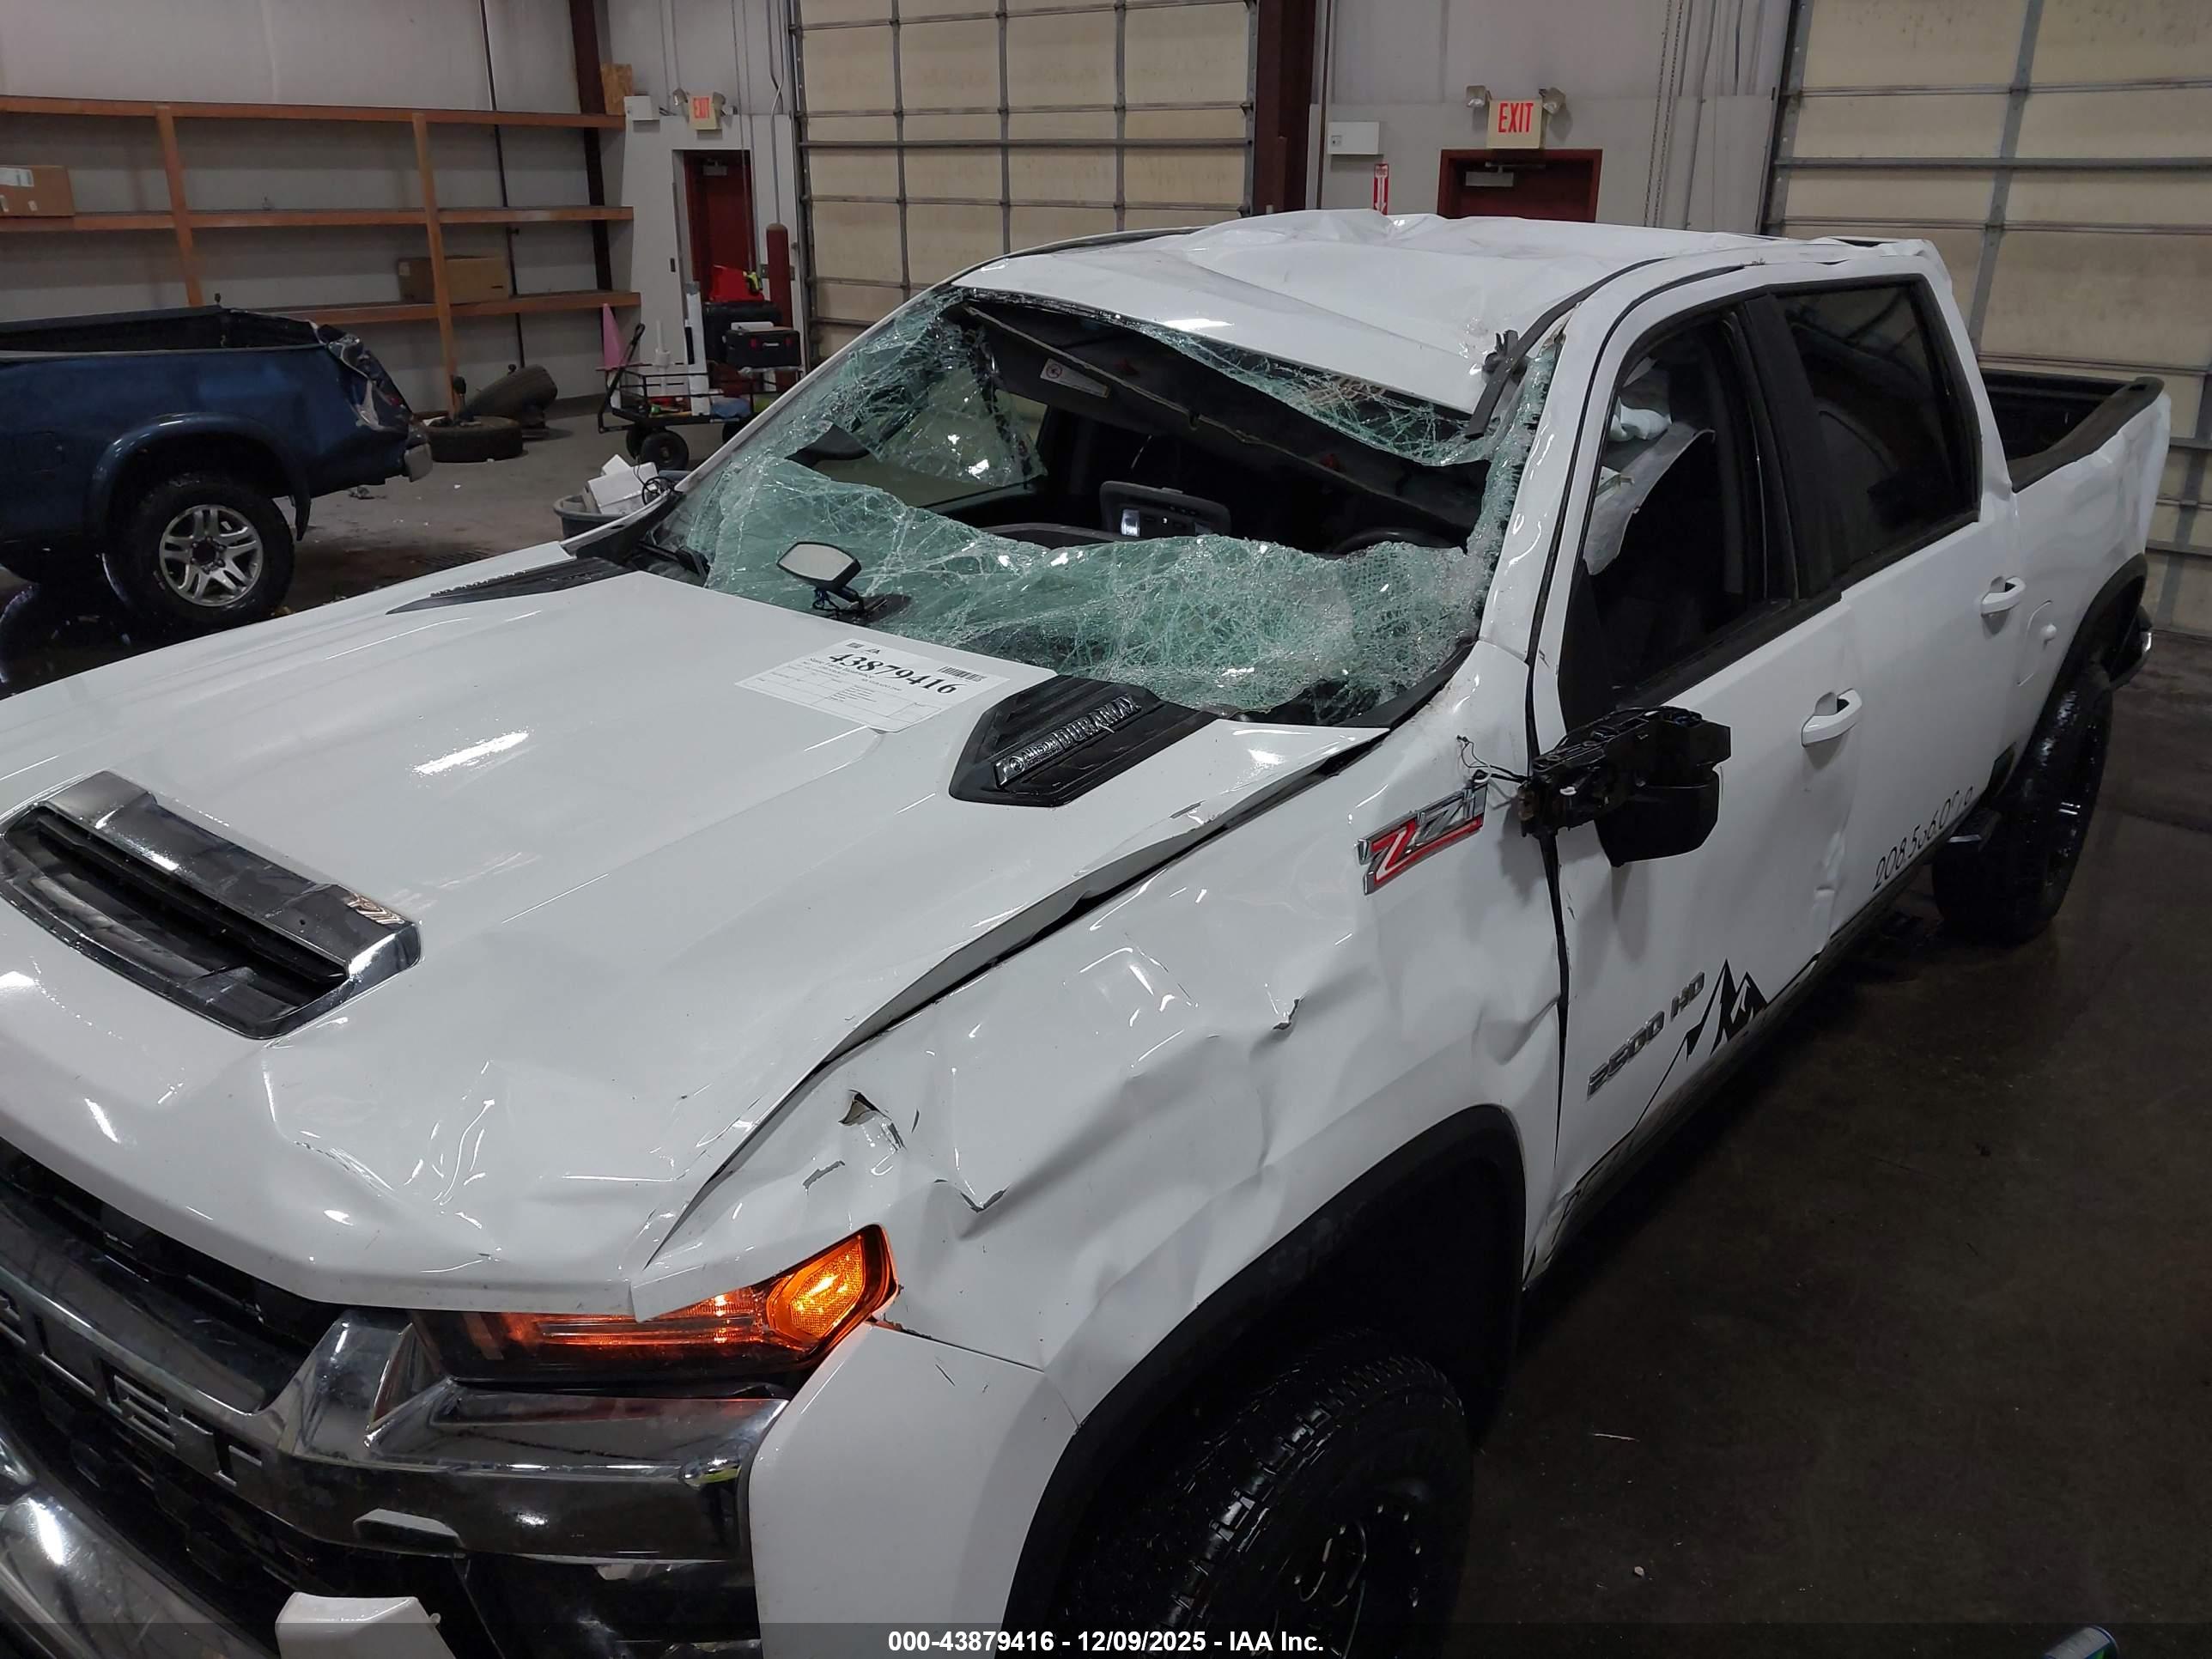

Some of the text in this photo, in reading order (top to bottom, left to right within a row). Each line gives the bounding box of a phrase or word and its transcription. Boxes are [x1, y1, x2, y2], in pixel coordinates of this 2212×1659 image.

[1498, 102, 1534, 133] EXIT
[828, 653, 963, 695] 43879416
[1055, 694, 1142, 746] DURAMAX
[1358, 781, 1488, 896] Z71
[1587, 970, 1705, 1100] 2500 HD
